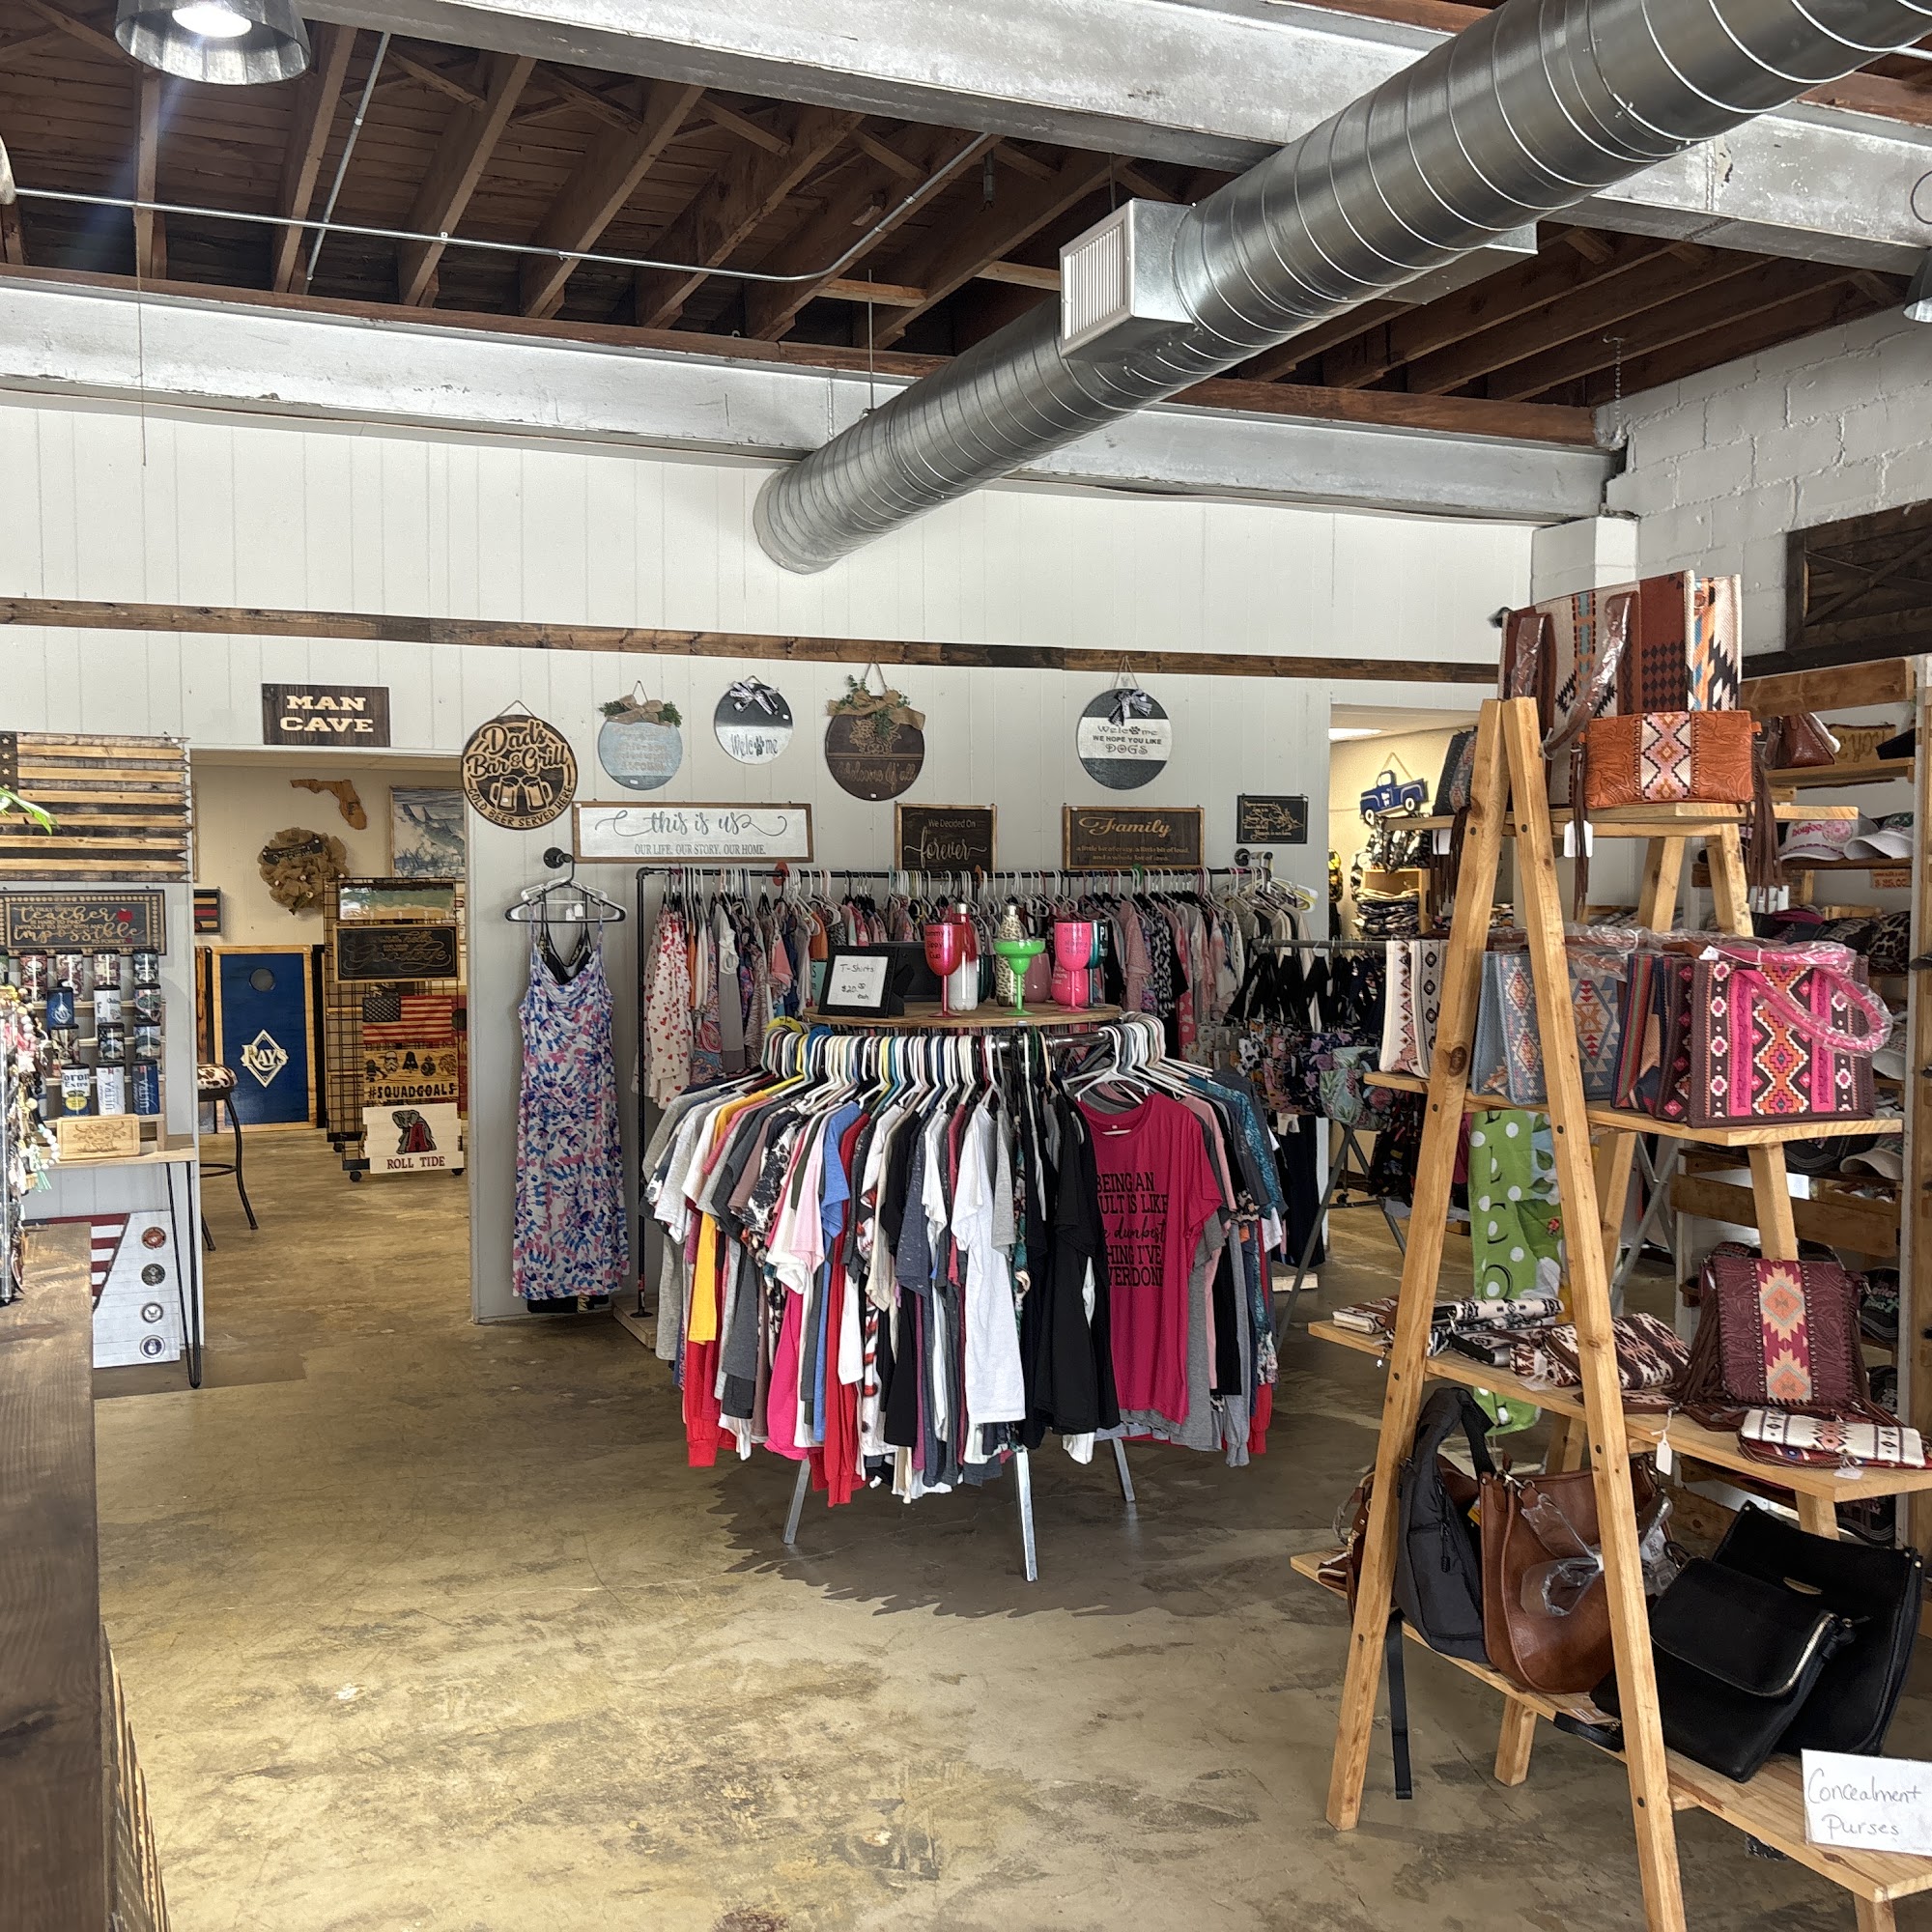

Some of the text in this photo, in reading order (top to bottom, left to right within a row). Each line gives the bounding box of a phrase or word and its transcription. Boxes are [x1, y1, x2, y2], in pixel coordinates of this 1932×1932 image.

[287, 695, 366, 711] MAN
[280, 716, 374, 732] CAVE
[481, 720, 548, 755] Dad's
[1105, 743, 1149, 755] DOGS
[465, 744, 569, 780] Bar & Grill
[468, 785, 574, 828] COLD BEER SERVED HERE
[695, 811, 710, 836] is
[927, 818, 977, 829] We Decided On
[1078, 815, 1172, 838] Family
[634, 843, 652, 855] OUR
[675, 844, 693, 855] OUR
[723, 844, 741, 856] OUR
[741, 845, 767, 856] HOME.
[906, 825, 985, 869] forever
[14, 905, 116, 923] teacher
[14, 922, 145, 944] impossible
[840, 964, 874, 973] T-Shirts
[241, 1044, 288, 1072] RAYS
[368, 1082, 458, 1099] #SQUADGOALS
[386, 1155, 445, 1170] ROLL TIDE
[1096, 1172, 1156, 1193] BEING AN
[1098, 1194, 1169, 1214] ULT IS LIKE
[1114, 1215, 1167, 1245] dumbest
[1106, 1244, 1162, 1265] HING I'VE
[1108, 1265, 1164, 1287] VERDONE
[1807, 1767, 1922, 1804] Concealment
[1820, 1813, 1900, 1840] Purses
